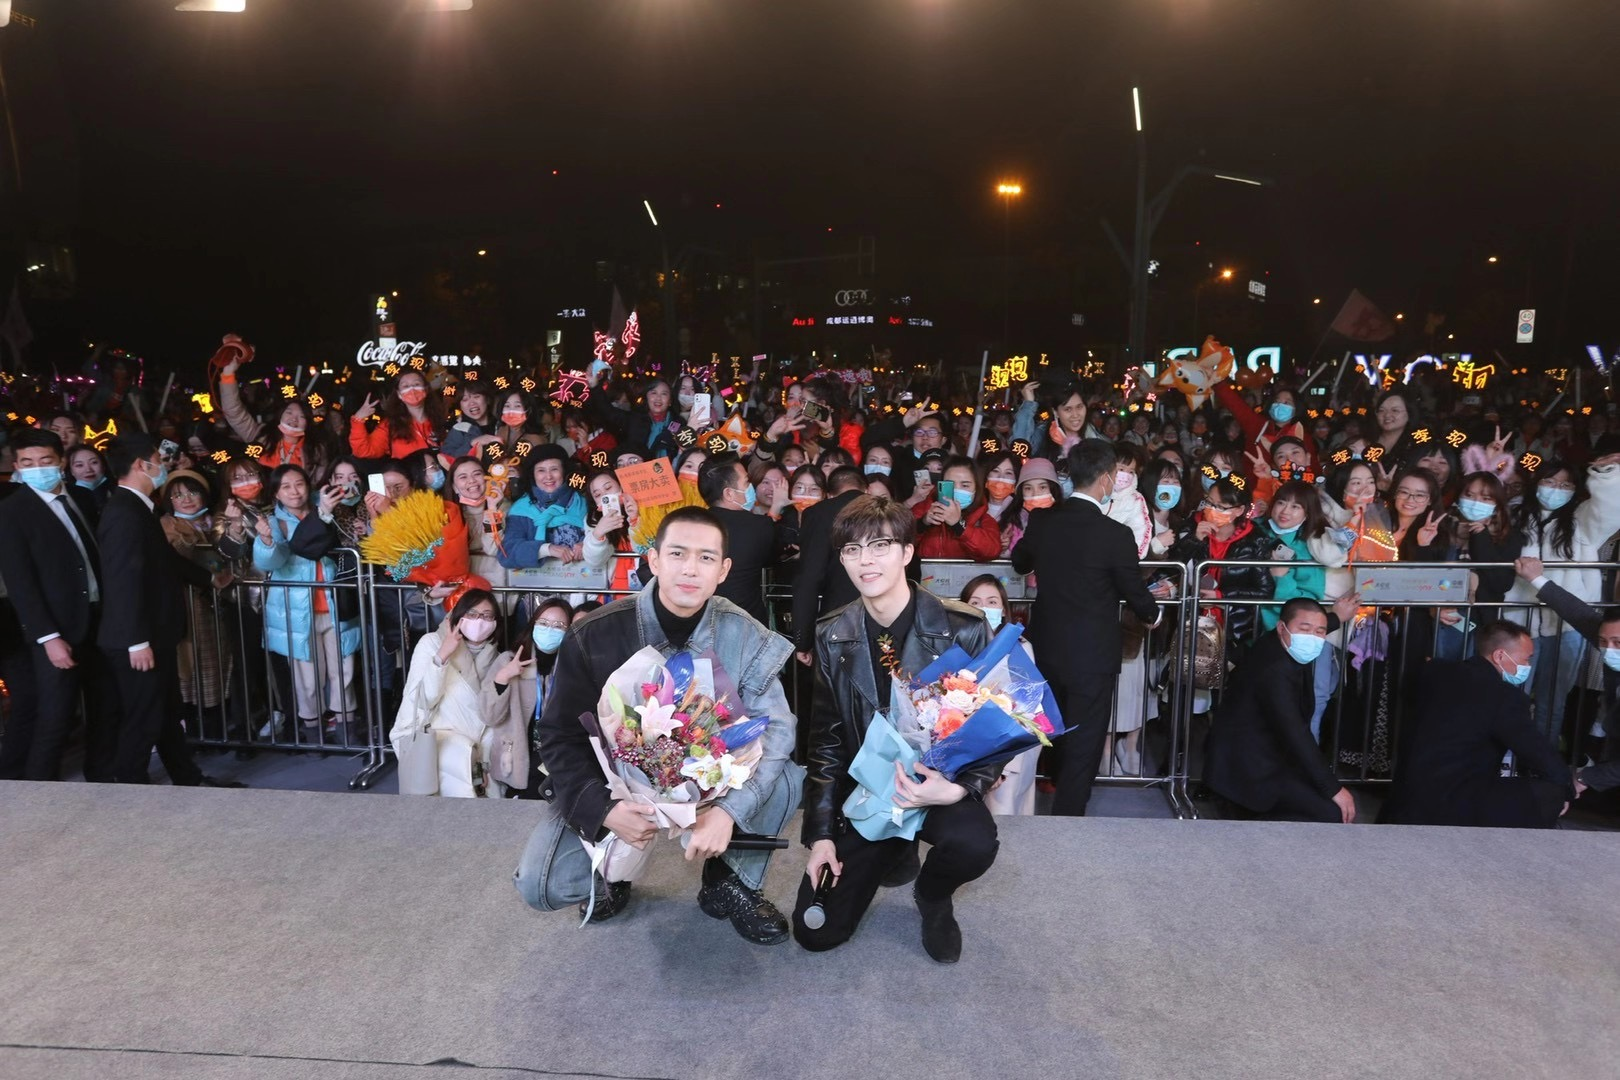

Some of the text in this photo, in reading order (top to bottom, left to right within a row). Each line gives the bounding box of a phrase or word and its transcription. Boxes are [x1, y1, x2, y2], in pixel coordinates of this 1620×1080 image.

[383, 356, 425, 378] 李 现
[464, 370, 479, 381] 现
[493, 376, 510, 390] 李
[519, 376, 536, 393] 现
[281, 384, 298, 399] 李
[307, 392, 324, 409] 现
[677, 429, 726, 454] 李 现
[981, 438, 1029, 458] 李 现
[1411, 428, 1467, 448] 李 现
[211, 444, 263, 465] 李 现
[486, 441, 531, 460] 李 现
[1331, 446, 1384, 466] 李 现
[568, 451, 609, 490] 李 现
[1519, 452, 1542, 472] 现
[629, 474, 672, 495] 票房大卖
[1201, 465, 1246, 491] 李 现
